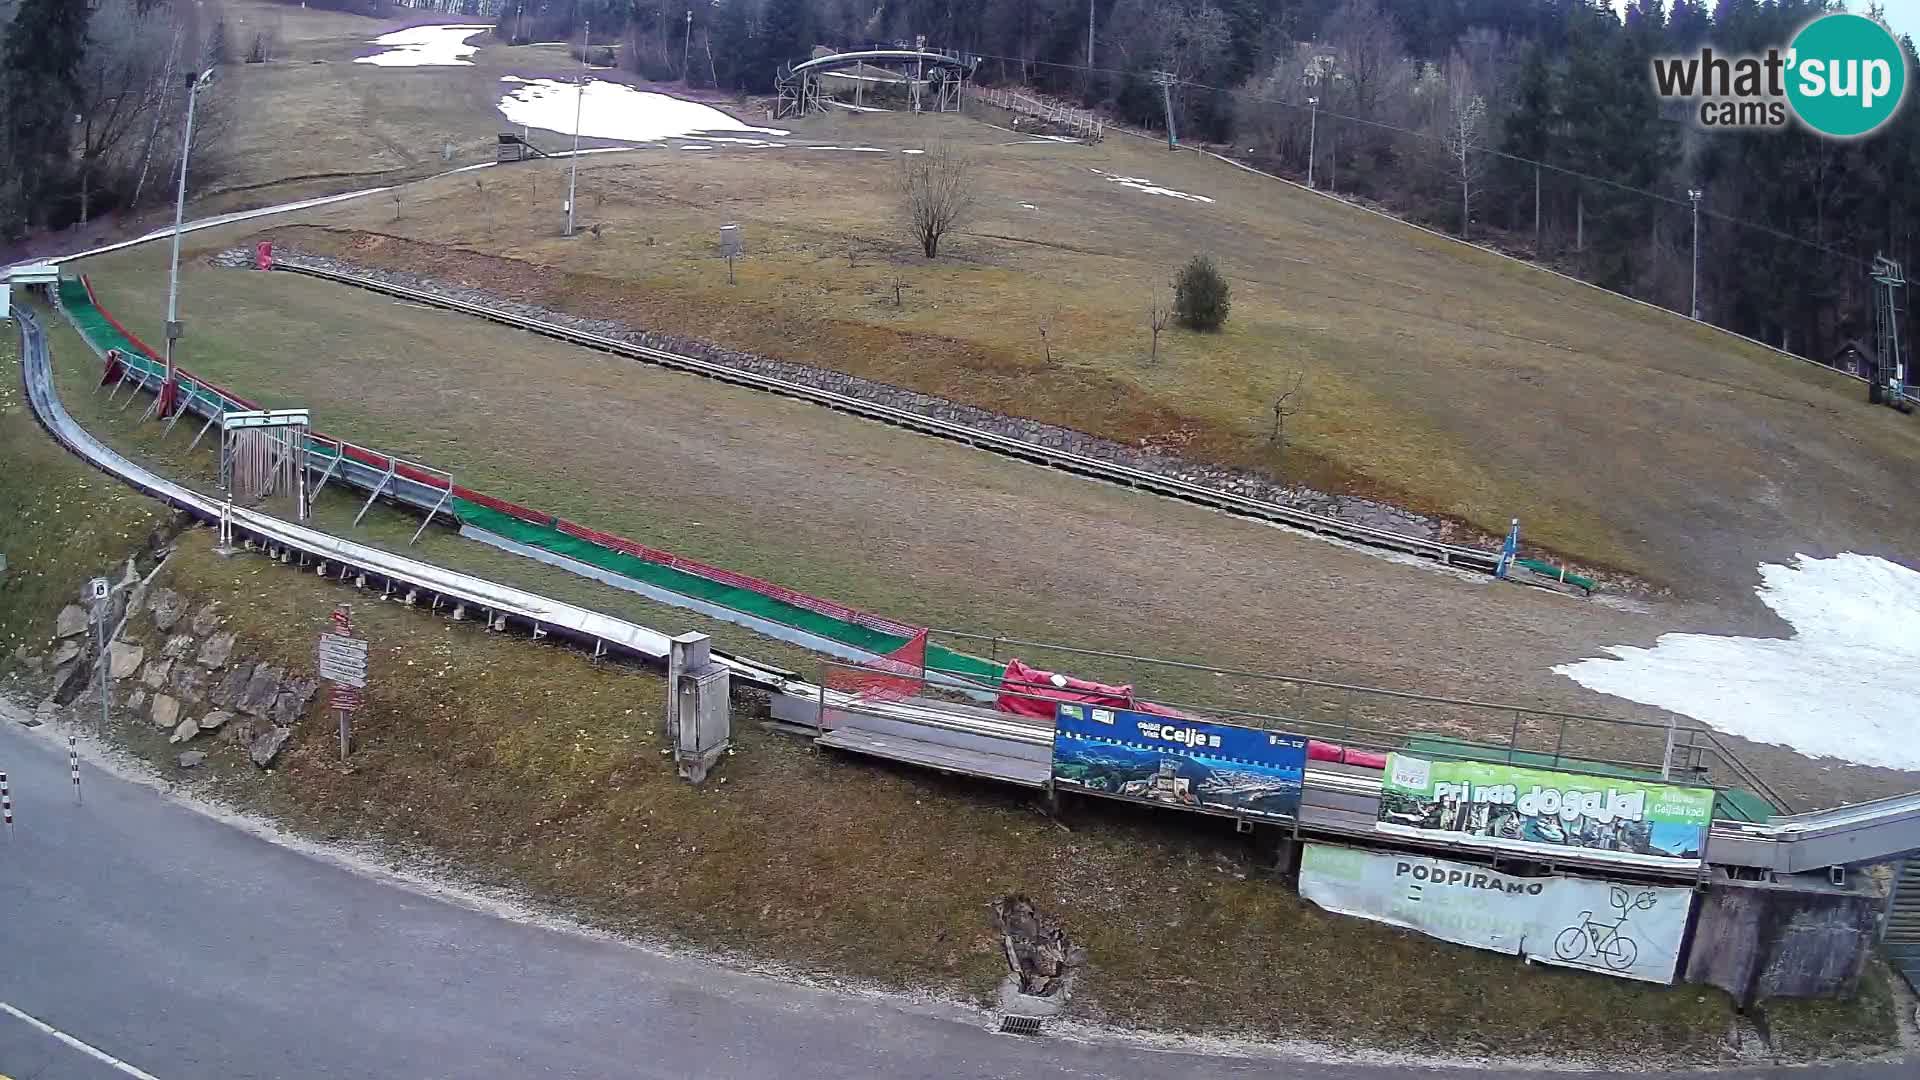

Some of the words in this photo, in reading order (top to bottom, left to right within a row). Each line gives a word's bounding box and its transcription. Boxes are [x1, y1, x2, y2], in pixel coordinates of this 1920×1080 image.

[1161, 725, 1207, 748] Celje
[1472, 784, 1517, 805] nas
[1517, 785, 1646, 824] dogaja!
[1395, 861, 1545, 895] PODPIRAMO
